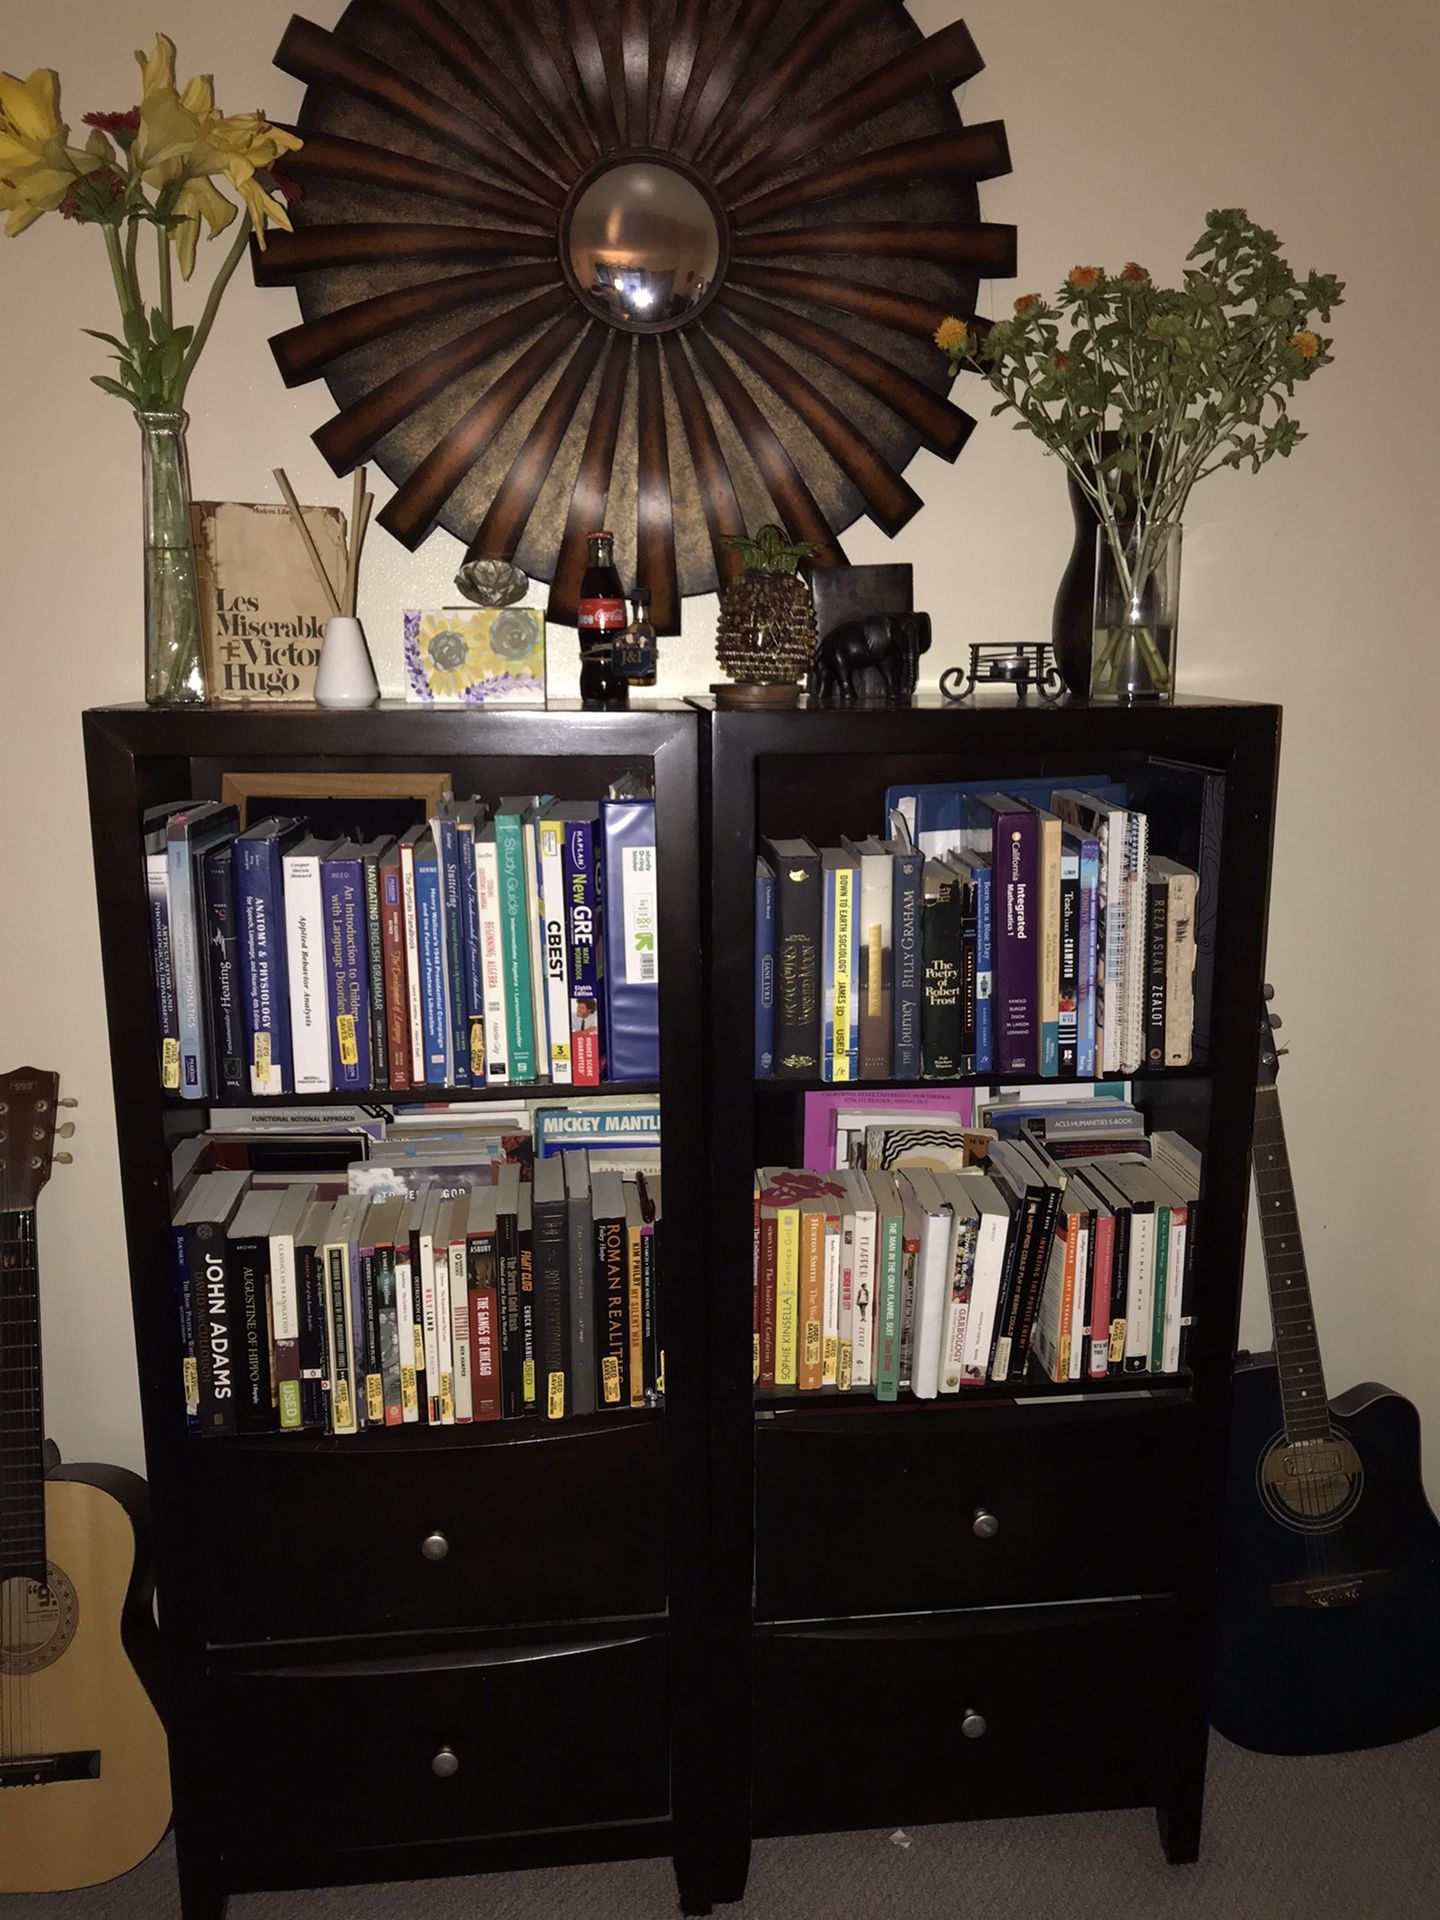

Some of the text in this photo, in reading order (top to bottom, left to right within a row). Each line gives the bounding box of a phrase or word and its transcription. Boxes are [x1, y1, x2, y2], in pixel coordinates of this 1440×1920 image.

[215, 588, 259, 612] Les
[216, 614, 328, 638] Miserable
[223, 664, 300, 697] Hugo
[503, 838, 517, 875] Study
[576, 830, 584, 866] KAPLAN
[1011, 842, 1021, 881] California
[447, 864, 457, 908] Stuttering
[506, 877, 519, 916] Guide
[573, 874, 593, 945] New GRE
[1007, 884, 1015, 930] Mathematics
[255, 898, 267, 946] ANATOMY
[406, 887, 416, 950] Syntax Handbook
[1016, 884, 1027, 939] Integrated
[1064, 891, 1074, 979] Teach CHAMPION
[1175, 919, 1189, 942] Bible
[331, 894, 347, 1016] with Language Disorders
[344, 886, 360, 1022] An Introduction to Children
[367, 865, 383, 1010] NAVIGATING ENGLISH GRAMMAR
[510, 918, 520, 987] Intermediate Algebra
[548, 920, 563, 982] CBEST
[838, 875, 848, 1003] DOWN EARTH SOCIOLOGY JAMES
[902, 891, 915, 988] BILLY GRAHAM
[154, 902, 170, 1033] PHONOLOGICAL IMPAIRMENTS
[162, 924, 174, 1011] ARTICULATORY AND
[299, 916, 312, 1027] Applied Behavior Analysis
[424, 929, 436, 1036] Future Postwar Liberalism
[430, 888, 444, 1049] Henry Wallace's Presidential Campaign
[487, 960, 497, 988] ALGEBRA
[575, 948, 583, 980] WORKBOOK
[925, 968, 959, 980] Poetry
[933, 960, 951, 969] The
[1151, 900, 1165, 1027] REZA ASLAN ZEALOT
[185, 975, 196, 1028] PHONETICS
[220, 962, 233, 1055] Fundamentals Hearing
[258, 962, 271, 1029] PHYSIOLOGY
[925, 986, 960, 996] Robert
[930, 995, 956, 1005] Frost
[251, 1008, 260, 1030] Edition
[340, 1017, 348, 1040] SAVES
[836, 1029, 844, 1055] USED
[899, 1001, 915, 1047] Journey
[555, 1063, 567, 1071] 3rd
[578, 1037, 586, 1073] GUARANTEED
[544, 1117, 600, 1132] MICKEY
[1054, 1118, 1132, 1127] ACLS HUMANITIES E-BOOK
[470, 1245, 491, 1253] ASBURY
[520, 1250, 533, 1292] FIGHT CLUB
[783, 1229, 792, 1287] Twenties Girl
[810, 1219, 818, 1282] HUSTON SMITH
[860, 1237, 868, 1277] FLAPPER
[1068, 1232, 1076, 1264] HOFFMAN
[383, 1278, 391, 1305] Wartime
[633, 1260, 641, 1287] PHILBY
[886, 1222, 897, 1336] THE MAN IN THE GRAY FLANNEL SUIT
[1018, 1237, 1047, 1349] INVENTING PUBLIC ENEMY
[205, 1254, 230, 1399] JOHN ADAMS
[244, 1266, 260, 1381] AUGUSTINE OF HIPPO
[280, 1286, 289, 1334] TRANSLATION
[606, 1224, 624, 1384] ROMAN REALIT
[631, 1302, 639, 1330] SILENT
[477, 1297, 492, 1376] THE GANGS CHICAGO
[524, 1305, 533, 1361] CHUCK PALAHNI
[765, 1326, 773, 1363] Confucius
[782, 1297, 792, 1380] SOPHIE KINSELLA
[954, 1309, 966, 1363] GARBOLOGY
[284, 1385, 297, 1416] USED
